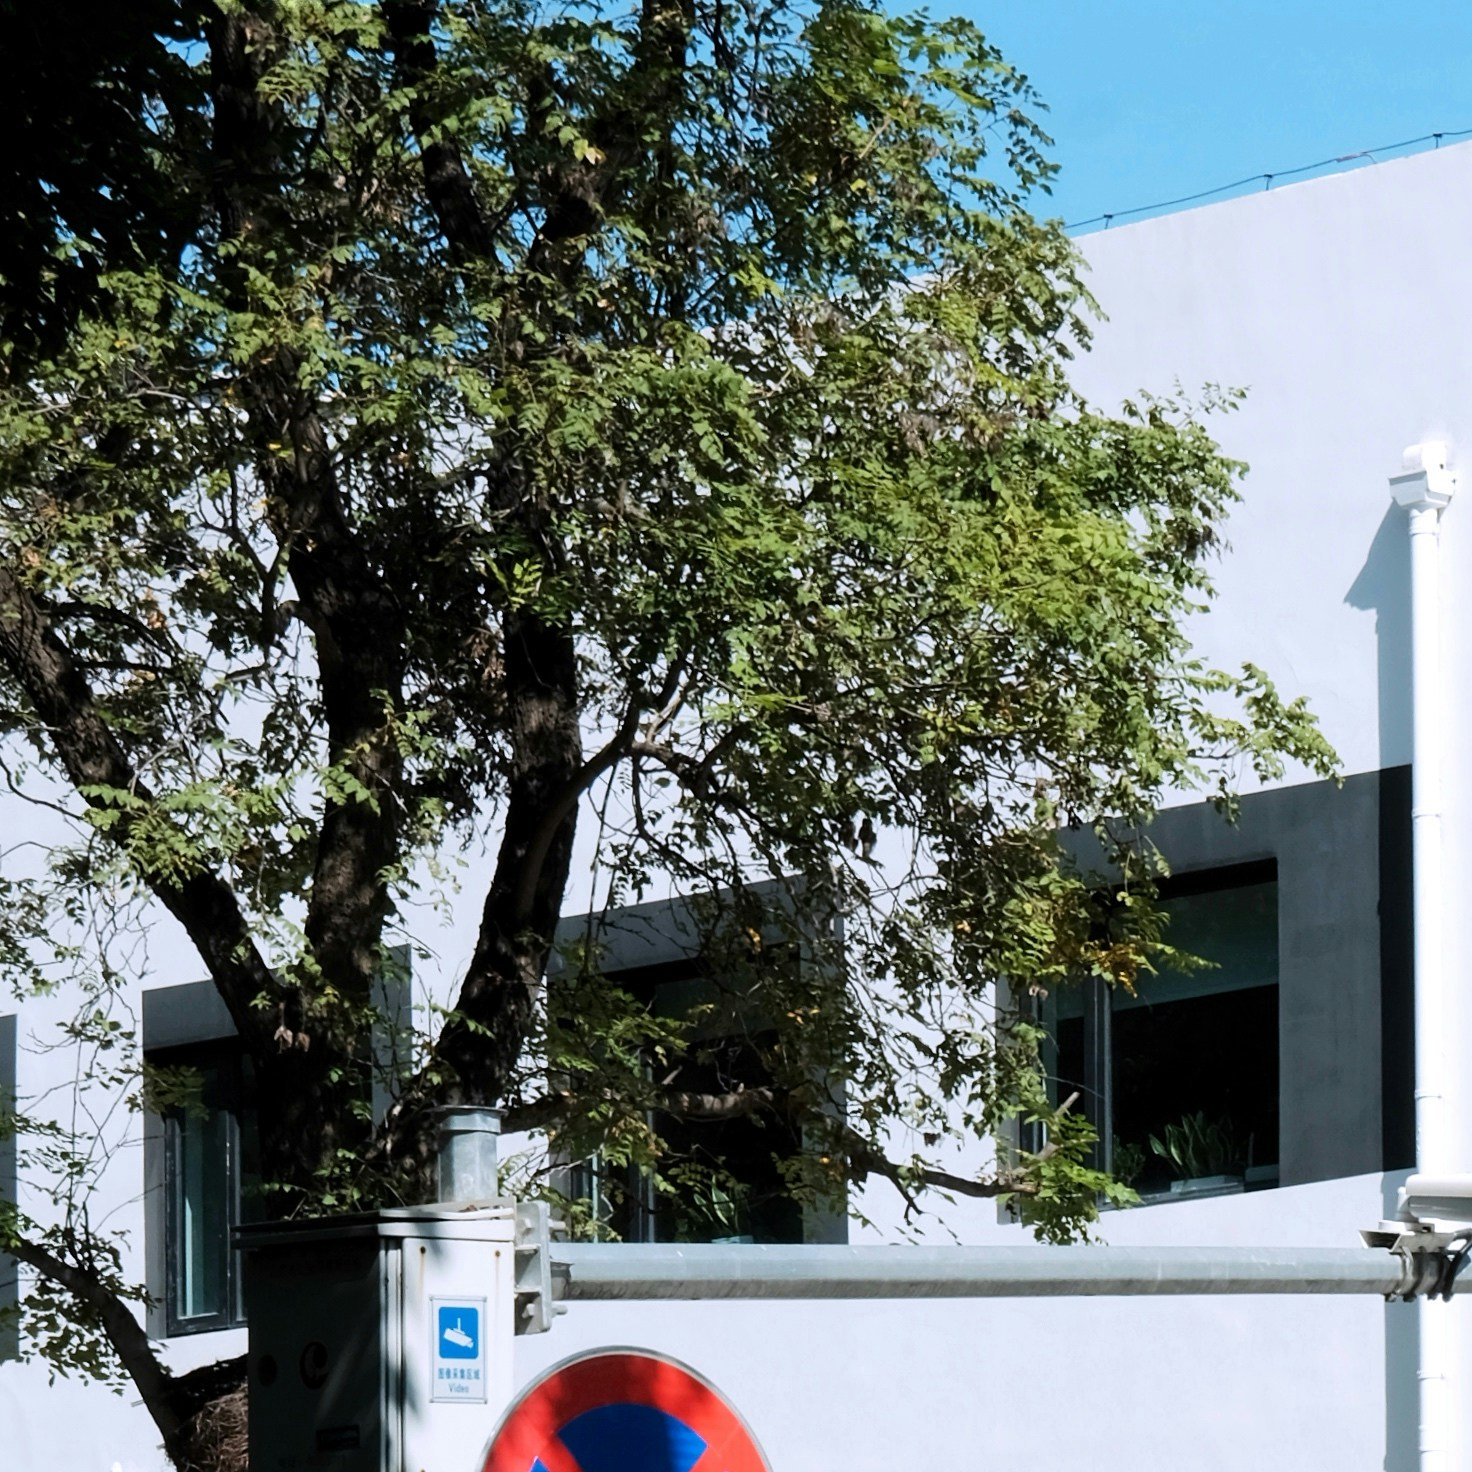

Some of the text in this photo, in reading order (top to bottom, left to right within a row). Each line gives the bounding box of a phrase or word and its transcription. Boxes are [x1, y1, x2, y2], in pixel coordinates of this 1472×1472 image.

[438, 1368, 480, 1380] 图像采集区域
[448, 1383, 470, 1393] Video
